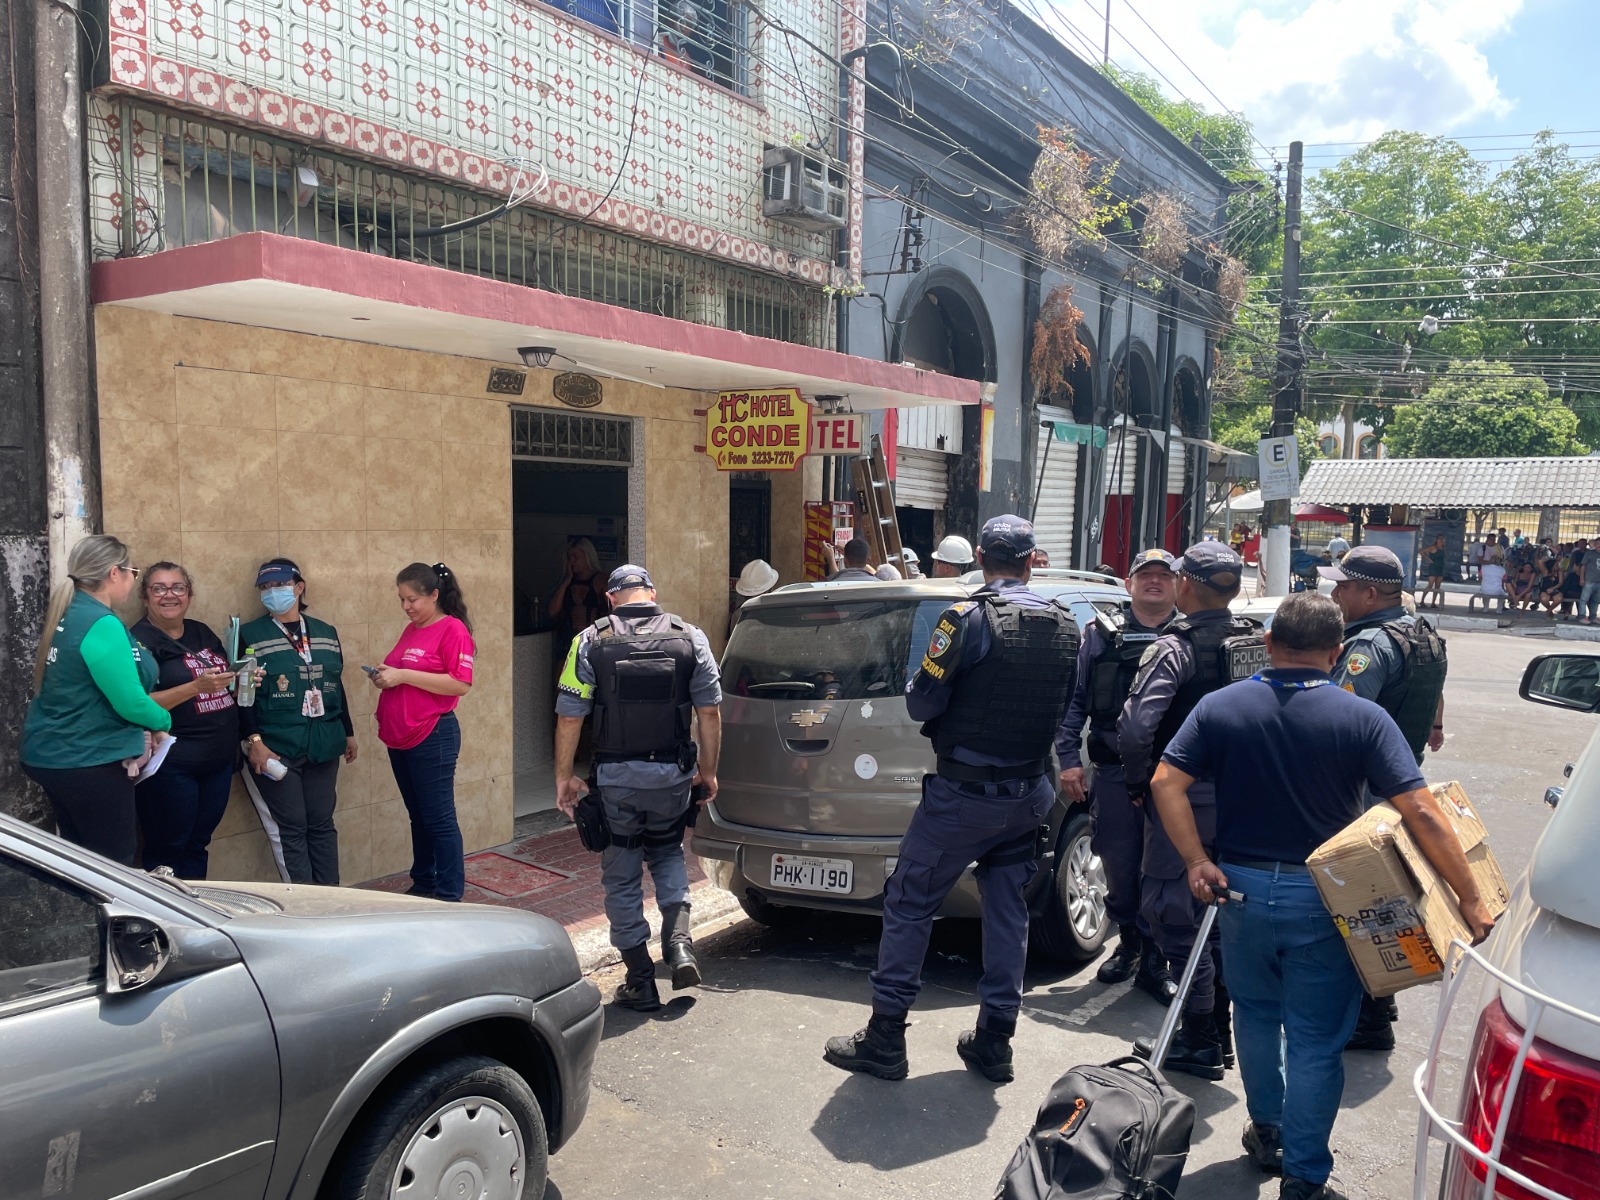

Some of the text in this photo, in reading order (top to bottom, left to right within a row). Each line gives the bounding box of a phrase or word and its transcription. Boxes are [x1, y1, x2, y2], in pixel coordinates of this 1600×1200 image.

[718, 393, 794, 423] HC HOTEL
[711, 424, 800, 447] CONDE
[811, 420, 860, 449] TEL
[728, 451, 794, 465] Fone 3233-7276
[1273, 444, 1285, 462] E
[940, 619, 957, 635] CMT
